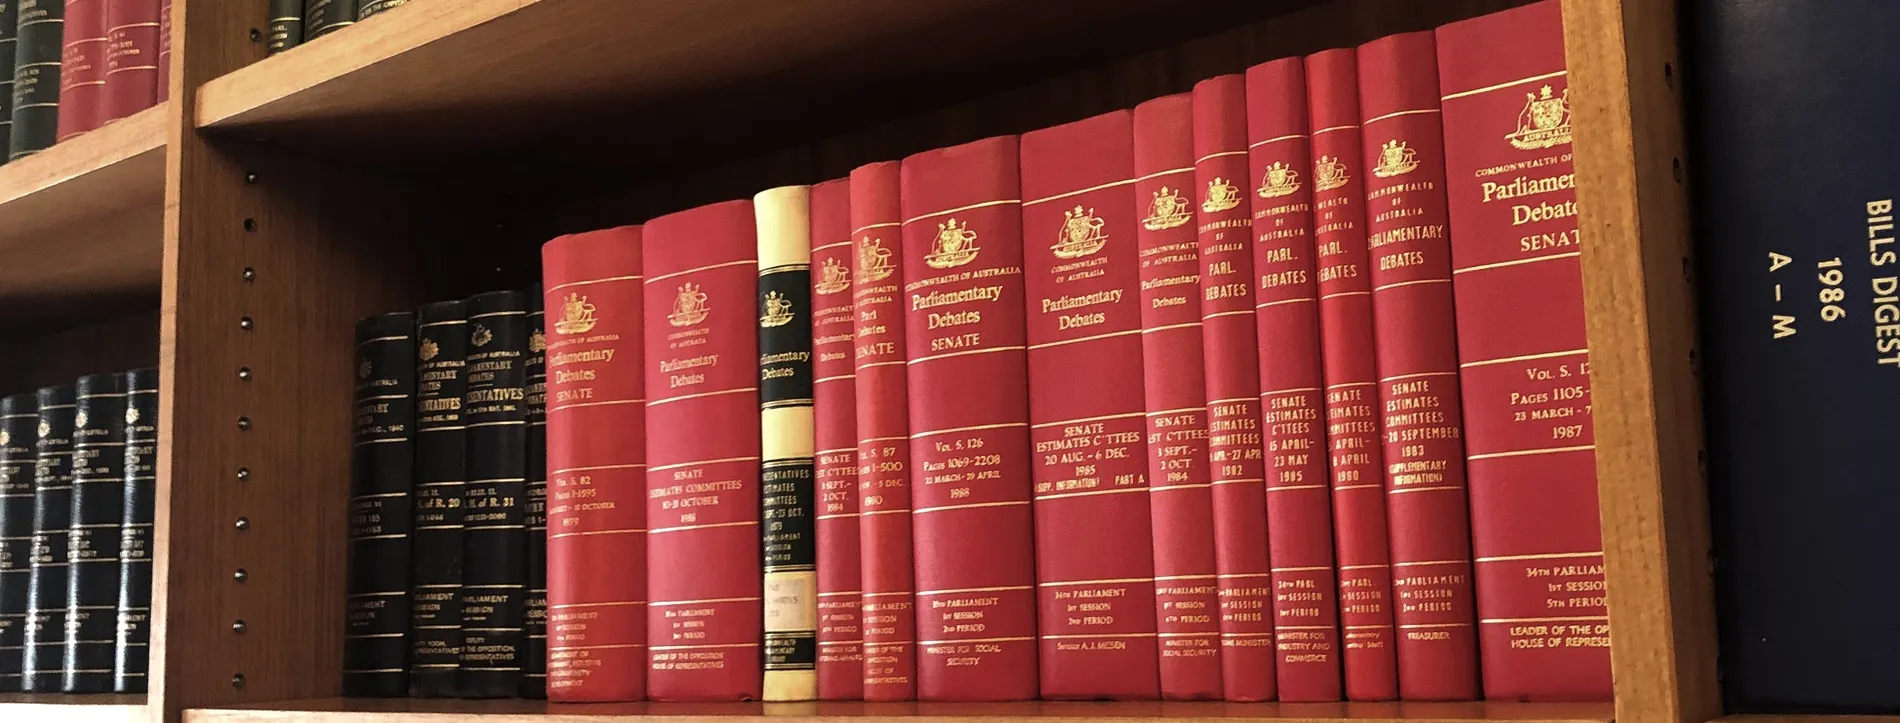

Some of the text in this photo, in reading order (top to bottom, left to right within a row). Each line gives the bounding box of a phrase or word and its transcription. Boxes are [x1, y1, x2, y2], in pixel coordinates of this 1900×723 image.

[1475, 157, 1559, 178] COMMONWEALTH
[1391, 197, 1402, 207] OF
[1255, 203, 1310, 220] COMMONWEALTH
[1324, 210, 1334, 220] OF
[1376, 207, 1424, 223] AUSTRALIA
[1275, 217, 1284, 227] OF
[1215, 231, 1225, 241] OF
[1259, 227, 1305, 243] AUSTRALIA
[1204, 241, 1244, 256] AUSTRALIA
[1266, 246, 1299, 264] PARL.
[1318, 240, 1348, 258] PARL.
[1050, 256, 1109, 274] COMMONWEALTH
[1153, 253, 1198, 266] AUSTRALIA
[1380, 251, 1425, 271] DEBATES
[1768, 251, 1793, 273] A
[961, 271, 971, 280] OF
[972, 266, 1021, 279] AUSTRALIA
[1067, 268, 1105, 282] AUSTRALIA
[1208, 260, 1237, 277] PARL.
[1141, 274, 1201, 291] Parliamentary
[1261, 269, 1307, 289] DEBATES
[1866, 199, 1900, 369] BILLS DIGEST
[1205, 282, 1248, 301] DEBATES
[1816, 256, 1847, 323] 1986
[912, 285, 1004, 311] Parliamentary
[1041, 288, 1124, 314] Parliamentary
[1151, 296, 1187, 310] Debates
[927, 310, 981, 330] Debates
[1058, 312, 1106, 331] Debates
[1771, 314, 1798, 340] M
[931, 332, 980, 352] SENATE
[556, 369, 596, 384] Debates
[762, 367, 795, 380] Debates
[1559, 364, 1572, 378] S.
[670, 373, 704, 389] Debates
[1391, 380, 1429, 396] SENATE
[557, 387, 593, 402] SENATE
[1270, 394, 1307, 410] SENATE
[1386, 396, 1440, 413] ESTIMATES
[1213, 404, 1248, 418] SENATE
[1265, 407, 1318, 424] ESTIMATES
[1514, 410, 1527, 422] 23
[1531, 406, 1574, 420] MARCH
[1155, 414, 1196, 429] SENATE
[1385, 411, 1444, 428] COMMITTEES
[1063, 423, 1105, 438] SENATE
[1401, 426, 1460, 442] SEPTEMBER
[1552, 424, 1583, 439] 1987
[967, 437, 984, 449] 126
[1036, 436, 1092, 453] ESTIMATES
[883, 446, 896, 458] 87
[1045, 446, 1131, 466] 20 AUG. 6 DEC.
[1401, 444, 1425, 458] 1983
[947, 454, 1001, 469] 1069-2208
[1160, 460, 1167, 471] 2
[1273, 453, 1309, 468] 23 MAY
[1340, 452, 1370, 465] APRIL
[673, 468, 704, 481] SENATE
[977, 470, 1001, 480] APRIL
[1167, 471, 1189, 483] 1984
[1221, 463, 1244, 477] 1982
[1280, 470, 1304, 483] 1985
[685, 479, 742, 493] COMMITTEES
[1114, 473, 1146, 486] PART A
[448, 497, 461, 509] 20
[502, 497, 515, 508] 31
[680, 495, 719, 508] OCTOBER
[1406, 574, 1465, 587] PARLIAMENT
[1072, 588, 1127, 599] PARLIAMENT
[1287, 592, 1323, 602] SESSION
[1413, 589, 1454, 600] SESSION
[946, 597, 999, 608] PARLIAMENT
[1079, 602, 1112, 612] SESSION
[1351, 604, 1380, 614] PERIOD
[1418, 601, 1453, 612] PERIOD
[953, 610, 984, 620] SESSION
[1290, 607, 1320, 617] PERIOD
[1083, 615, 1114, 625] PERIOD
[956, 623, 985, 632] PERIOD
[1510, 625, 1549, 636] LEADER
[1551, 624, 1567, 635] OF
[1569, 624, 1592, 635] THE
[1407, 631, 1451, 641] TREASURER
[1511, 637, 1545, 649] HOUSE
[1547, 637, 1562, 648] OF
